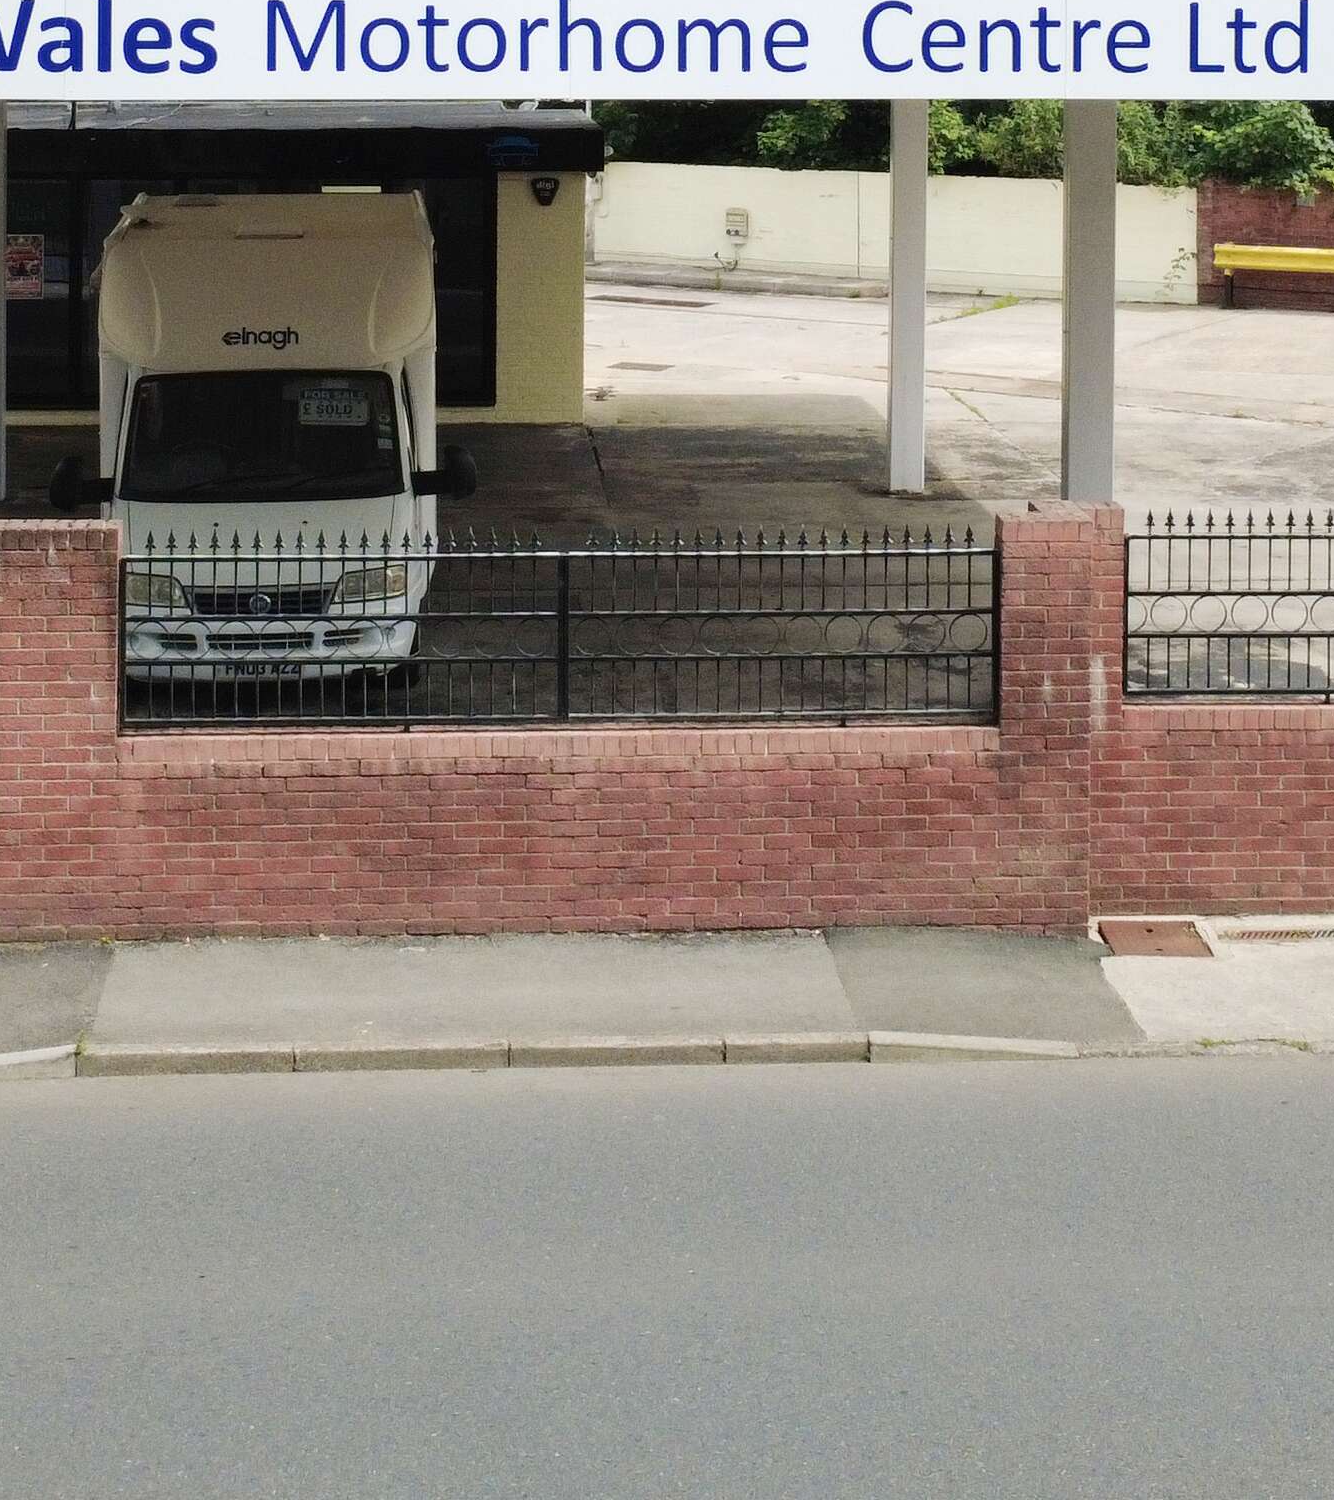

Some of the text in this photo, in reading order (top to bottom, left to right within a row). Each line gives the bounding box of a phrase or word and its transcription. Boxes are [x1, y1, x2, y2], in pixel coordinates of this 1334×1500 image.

[862, 0, 1151, 74] Centre
[222, 327, 299, 350] elnagh
[316, 403, 353, 415] SOLD
